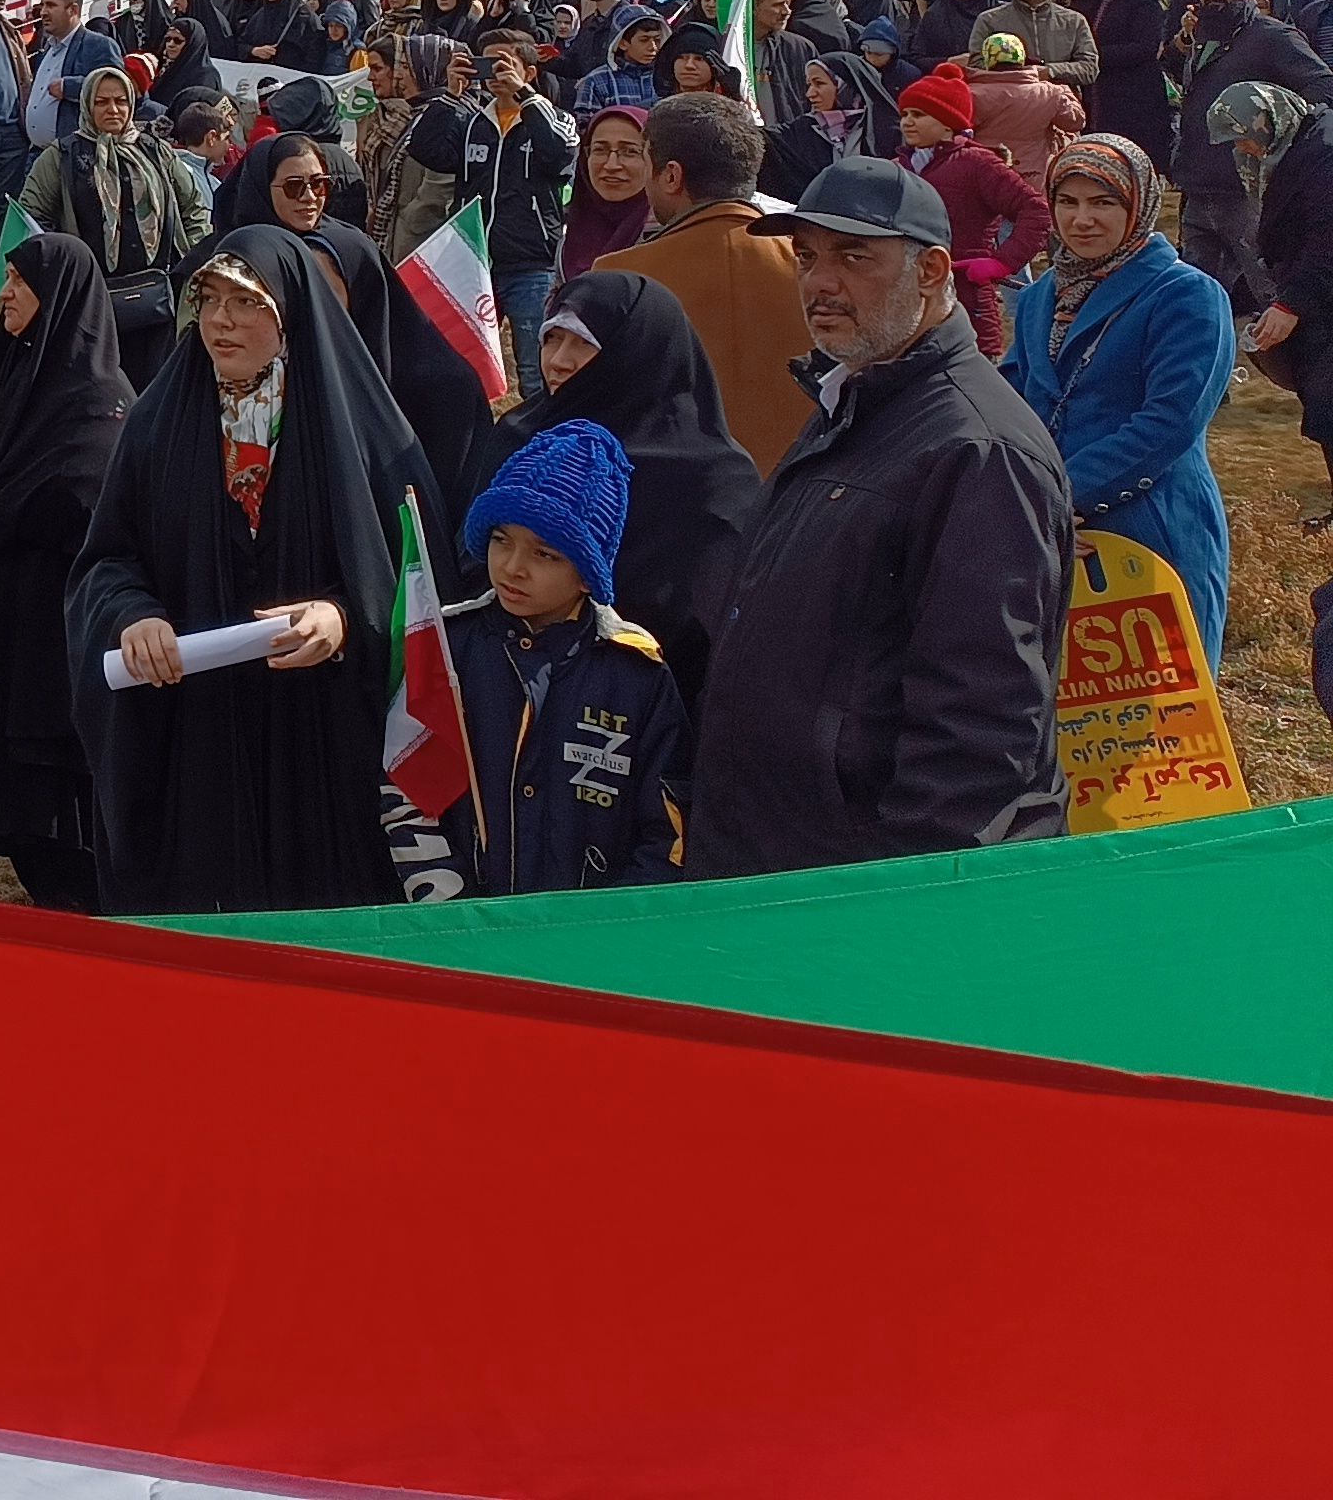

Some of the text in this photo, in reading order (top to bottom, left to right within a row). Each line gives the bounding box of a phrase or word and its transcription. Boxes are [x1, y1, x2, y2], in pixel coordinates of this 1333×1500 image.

[1059, 607, 1173, 680] US
[1056, 667, 1180, 700] DOWN WIT
[583, 706, 628, 733] LET
[1116, 703, 1152, 731] قوی
[1157, 701, 1197, 725] است
[1071, 736, 1118, 764] دارای
